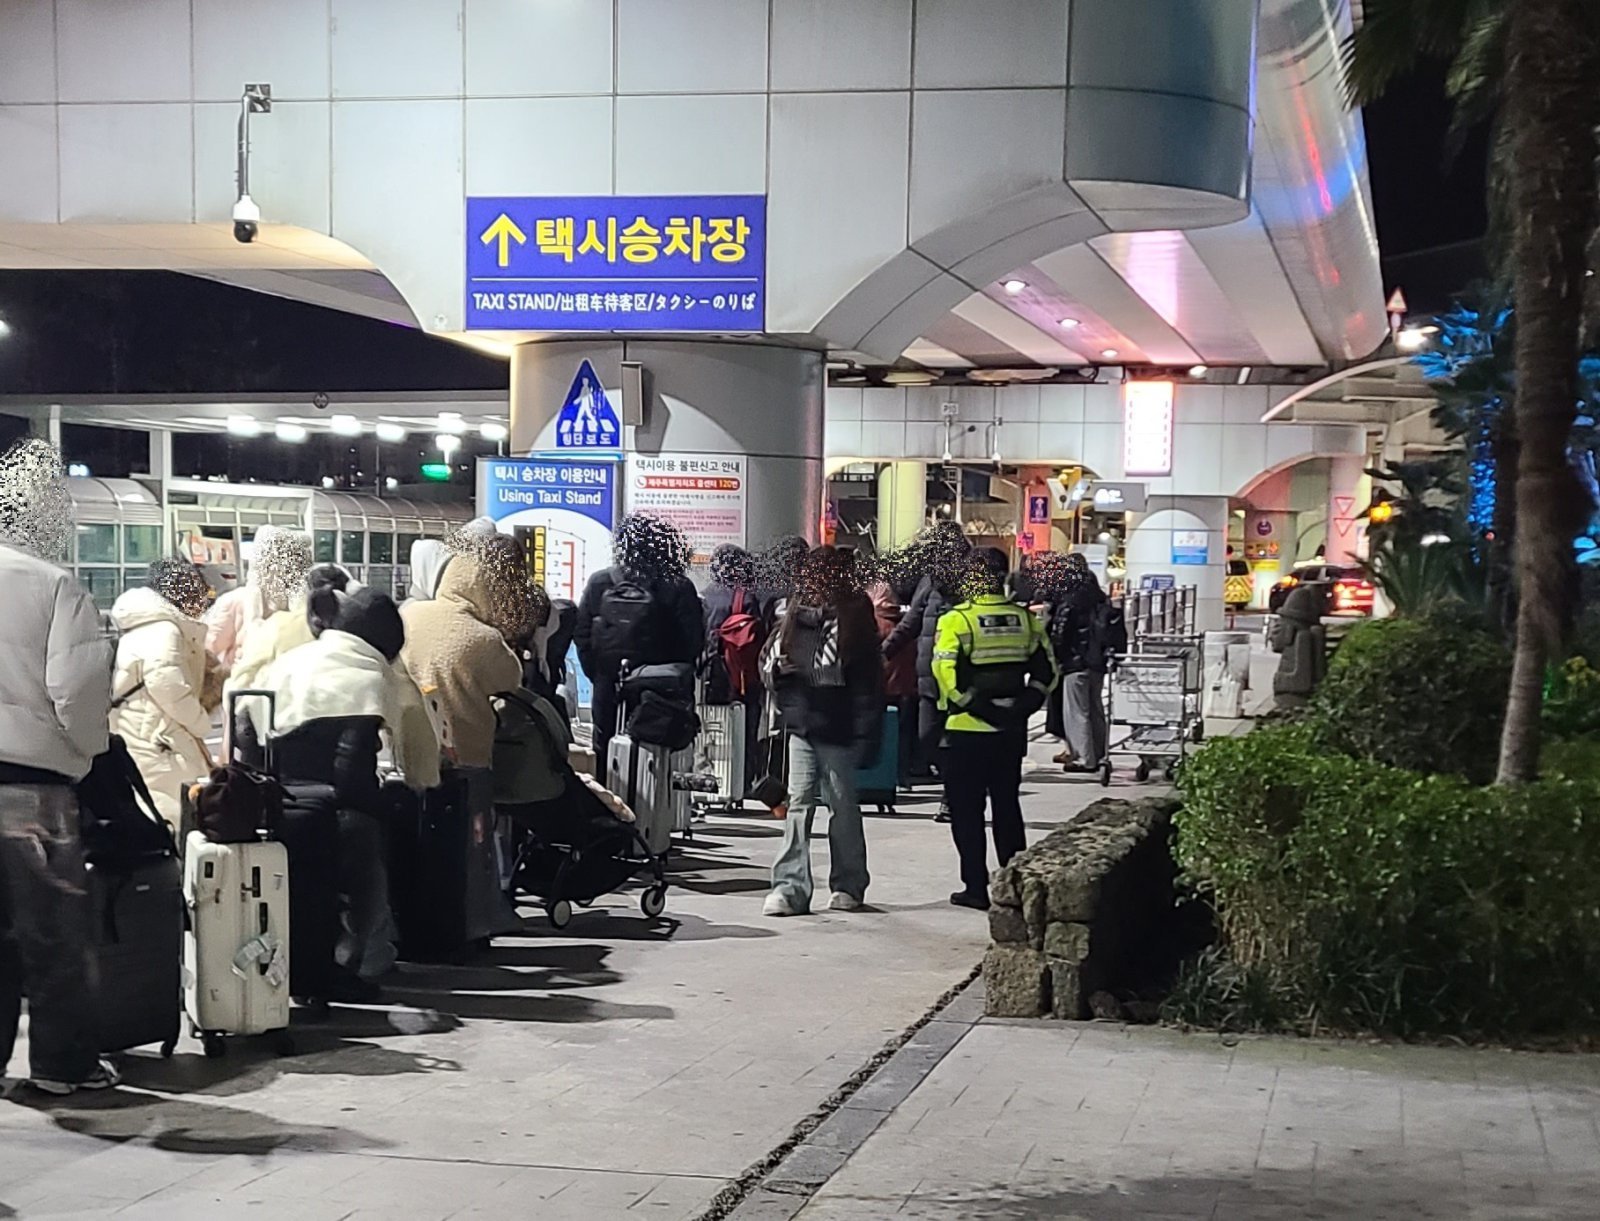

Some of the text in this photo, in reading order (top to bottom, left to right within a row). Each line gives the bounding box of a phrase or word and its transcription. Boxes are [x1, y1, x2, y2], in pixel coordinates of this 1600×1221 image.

[536, 216, 750, 263] 택시승차장
[472, 293, 505, 310] TAXI
[494, 465, 607, 484] 택시 승차장 이용안내
[636, 459, 740, 473] 택시이용 불편신고 안내
[498, 489, 601, 505] Using Taxi Stand
